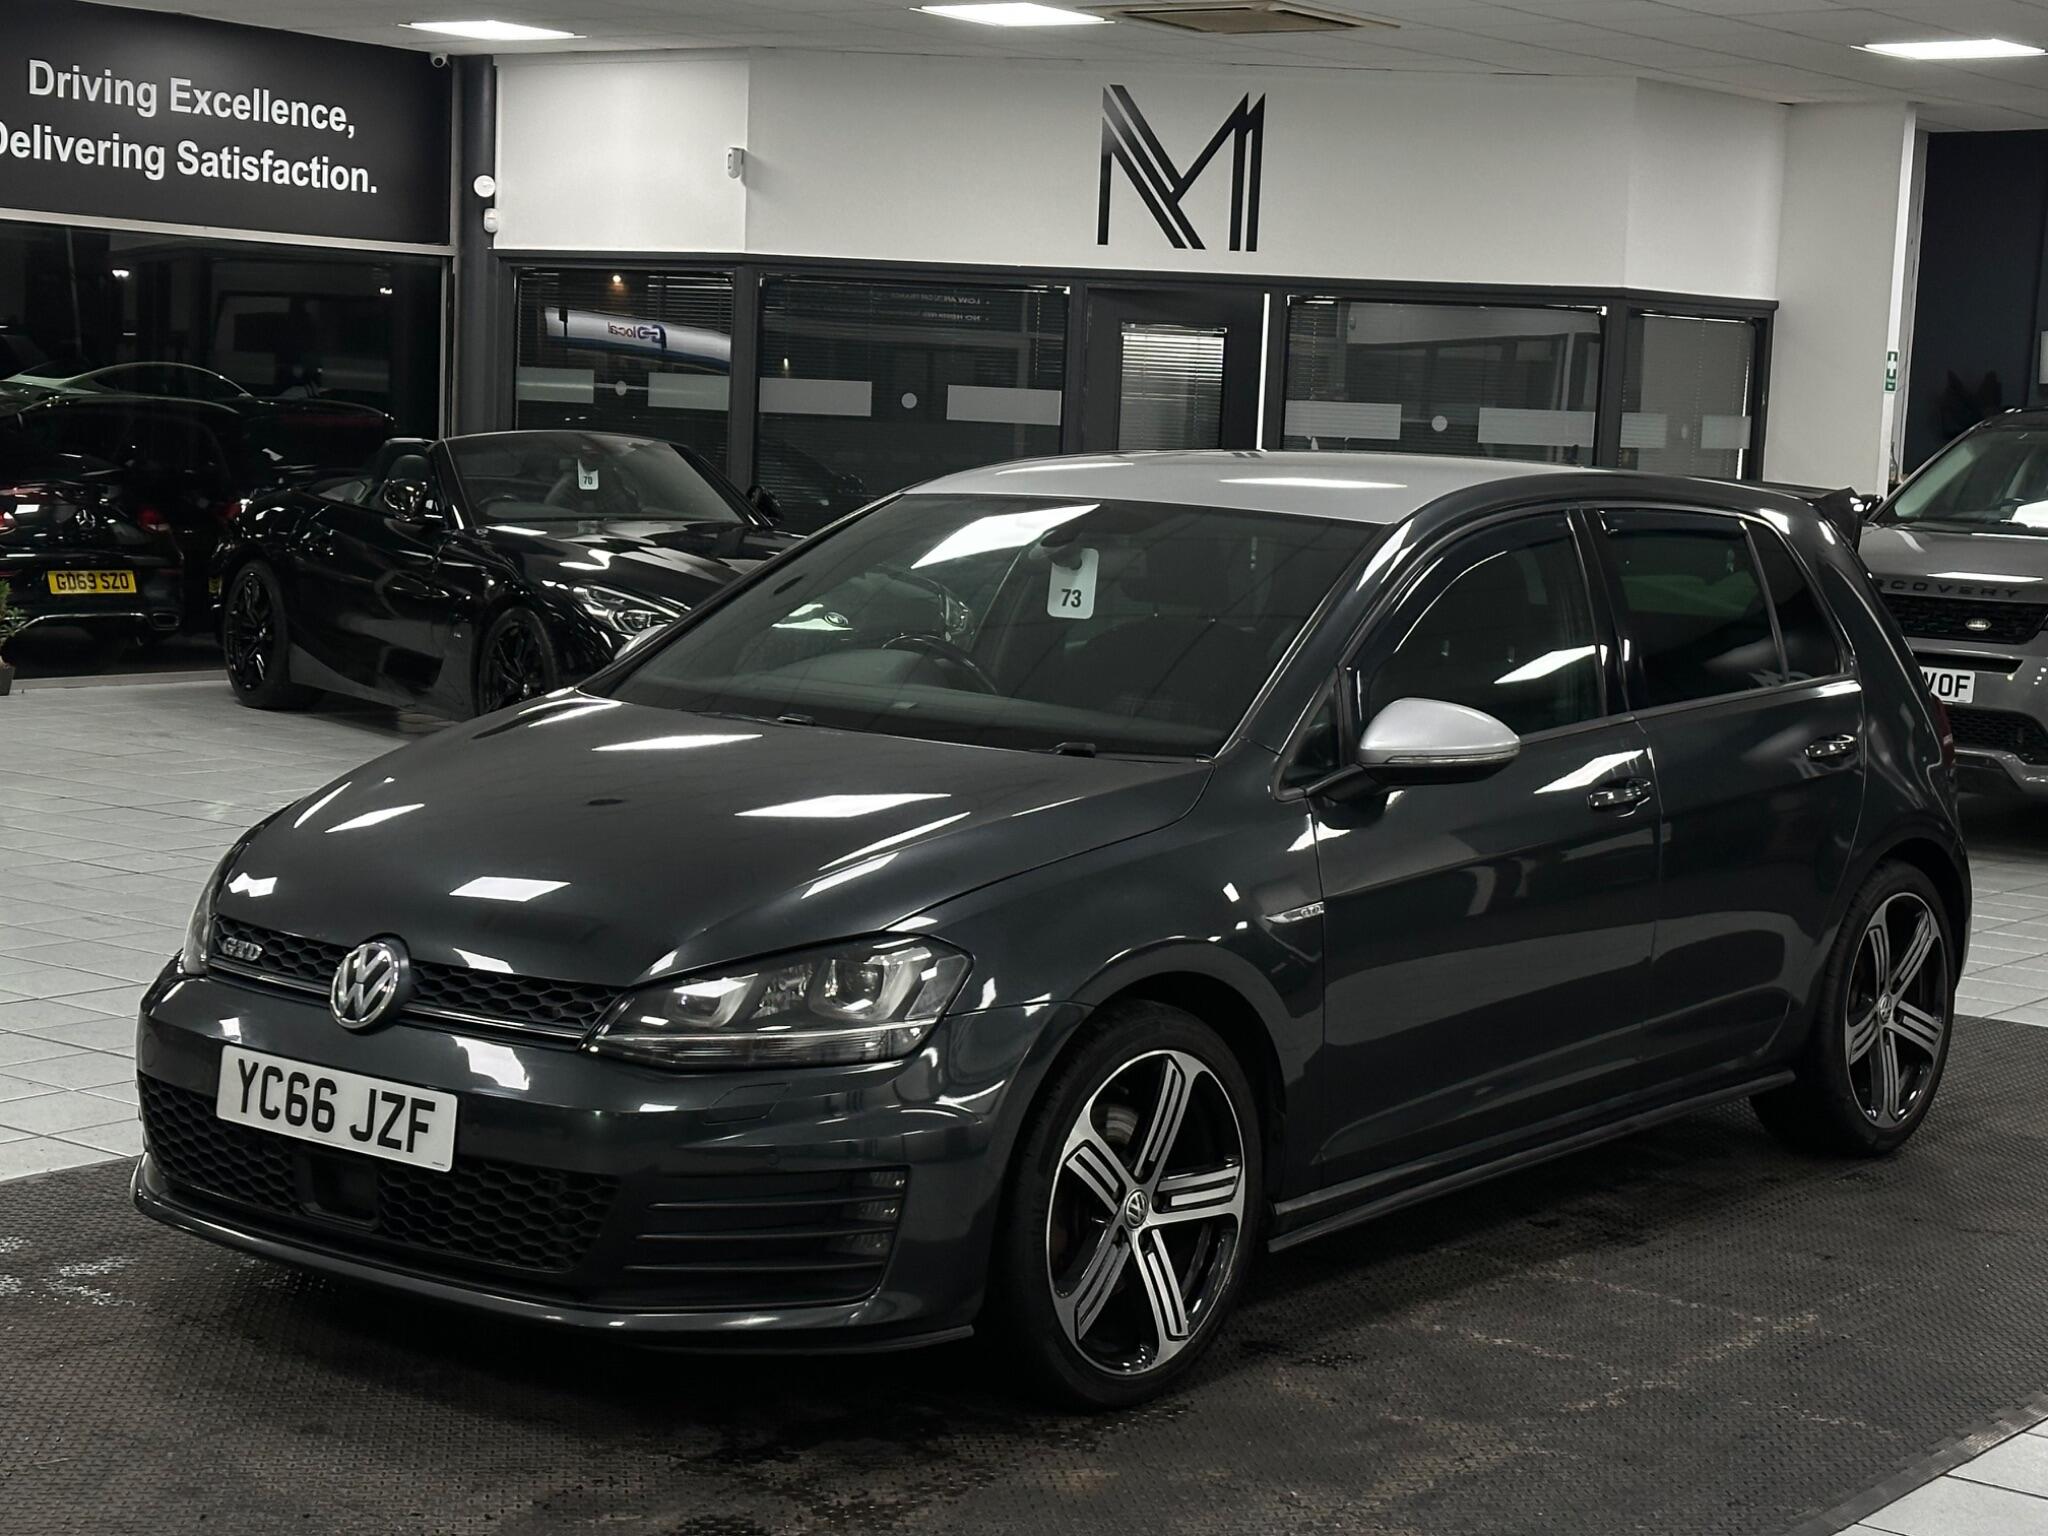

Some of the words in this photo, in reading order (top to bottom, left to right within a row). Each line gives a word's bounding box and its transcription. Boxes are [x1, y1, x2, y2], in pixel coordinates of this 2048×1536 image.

[29, 59, 157, 118] Driving
[169, 77, 355, 139] Excellence,
[176, 140, 378, 194] Satisfaction.
[55, 572, 97, 591] GD69
[99, 572, 130, 591] SZO
[1061, 588, 1082, 608] 73
[237, 1058, 338, 1134] YC66
[349, 1088, 437, 1154] JZF
